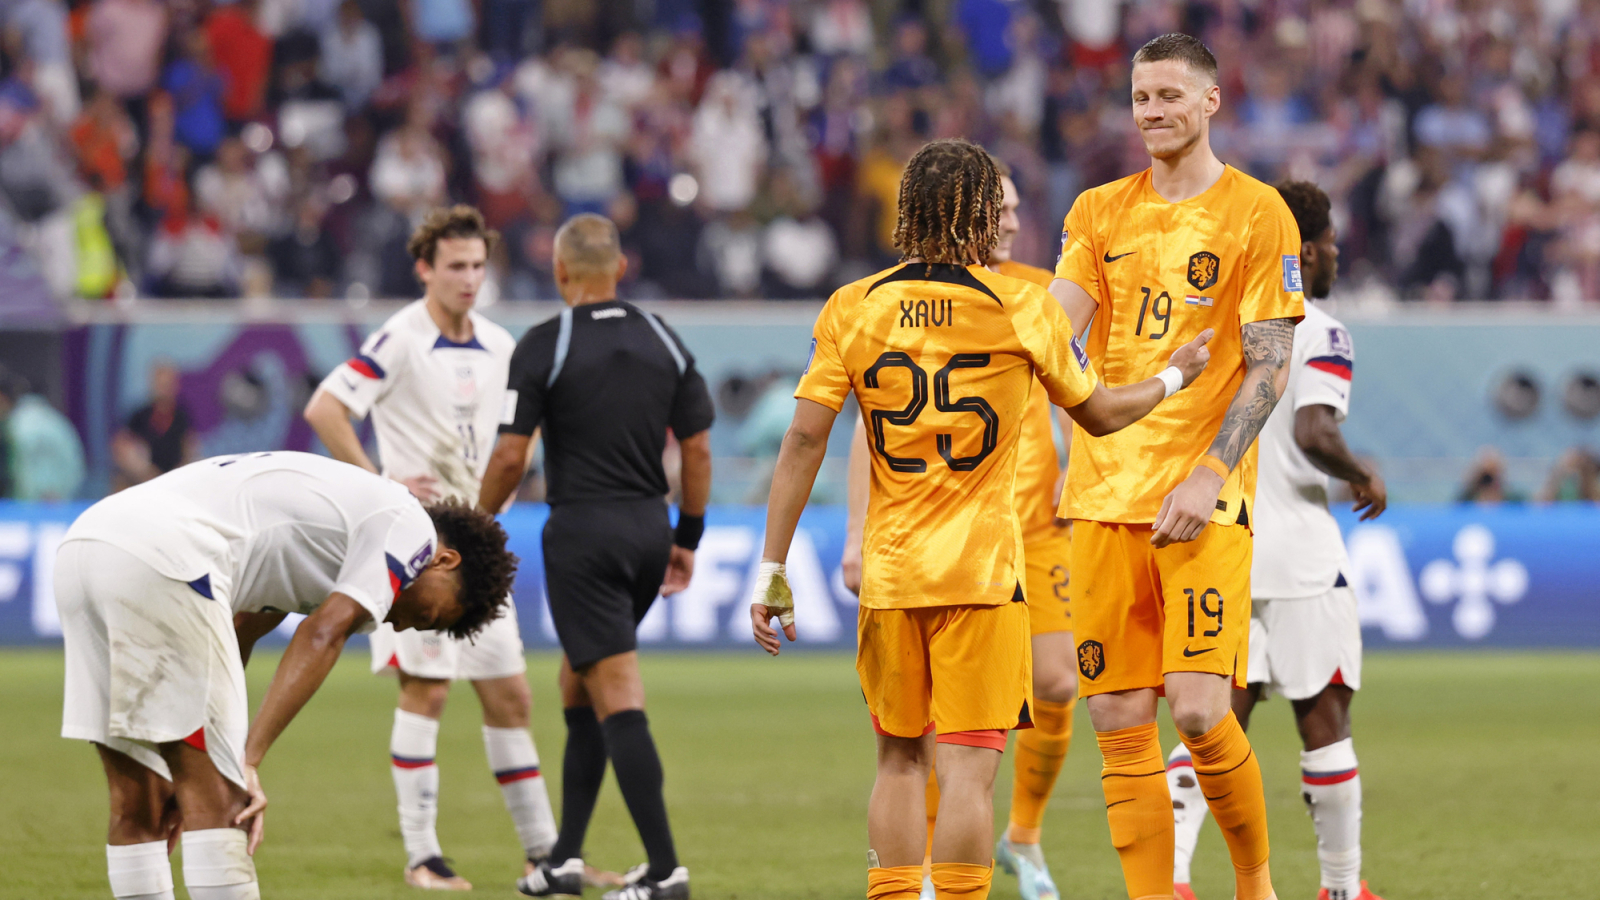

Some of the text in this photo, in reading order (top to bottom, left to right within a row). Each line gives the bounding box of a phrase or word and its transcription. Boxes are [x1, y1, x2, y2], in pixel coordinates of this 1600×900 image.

[900, 299, 952, 327] XAVI
[1135, 286, 1172, 339] 19
[864, 352, 999, 473] 25
[457, 424, 478, 461] 11
[1049, 564, 1071, 602] 2
[1183, 588, 1224, 637] 19
